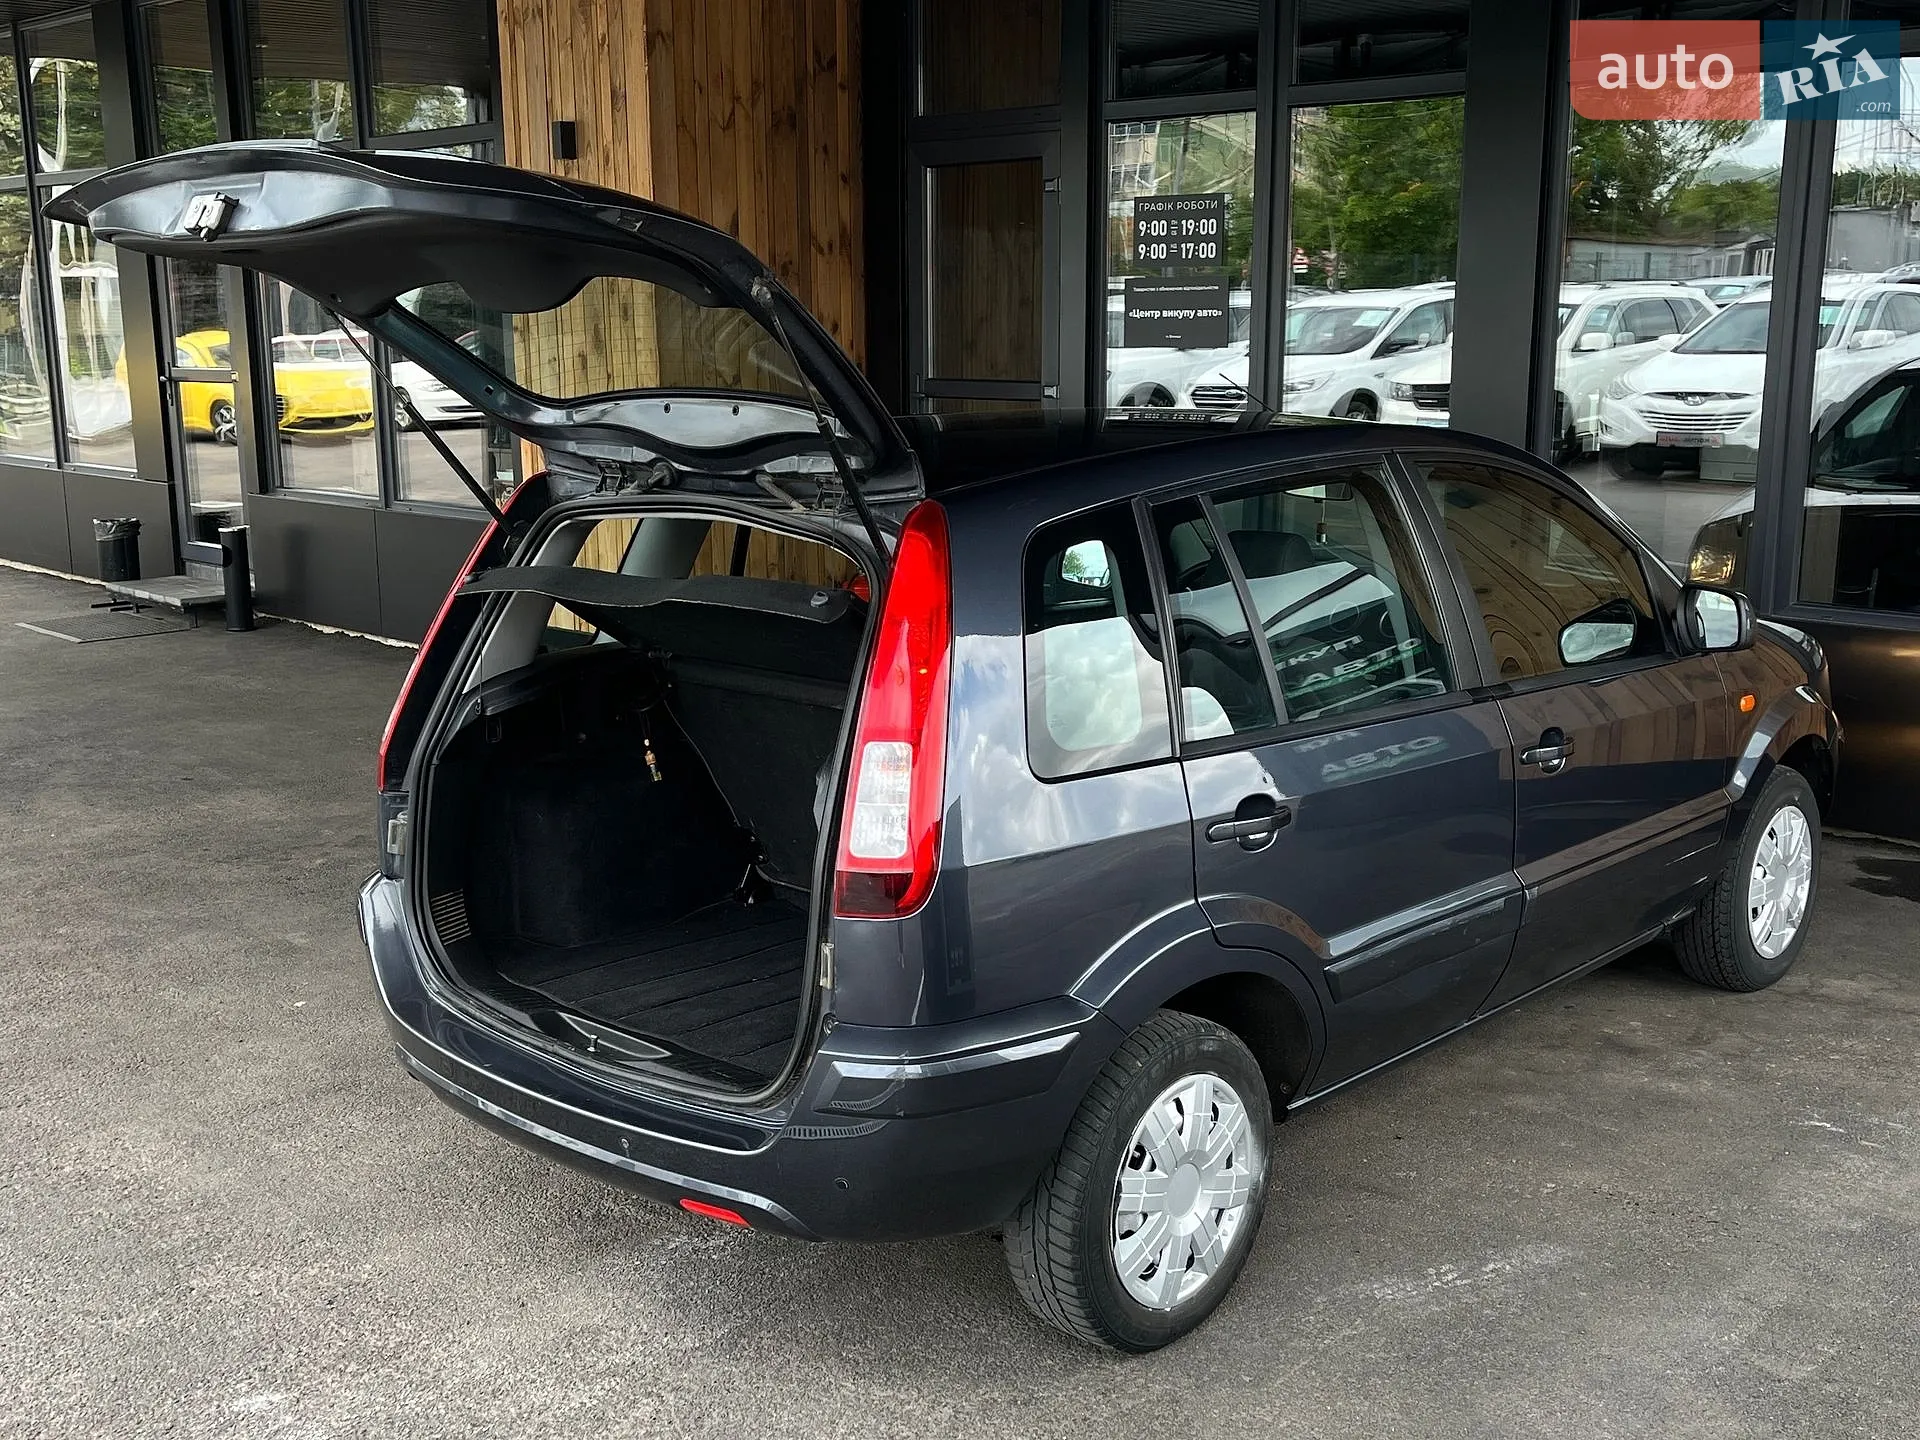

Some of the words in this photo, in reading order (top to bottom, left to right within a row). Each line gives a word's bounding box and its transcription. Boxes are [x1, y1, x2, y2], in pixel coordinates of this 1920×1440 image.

[1139, 202, 1174, 212] ГРАФІК
[1176, 200, 1218, 210] РОБОТИ
[1139, 220, 1167, 236] 9:00
[1181, 219, 1217, 235] 19:00
[1138, 243, 1167, 259] 9:00
[1180, 242, 1217, 259] 17:00
[1128, 308, 1161, 319] «Центр
[1162, 309, 1196, 319] викупу
[1196, 309, 1222, 317] авто»
